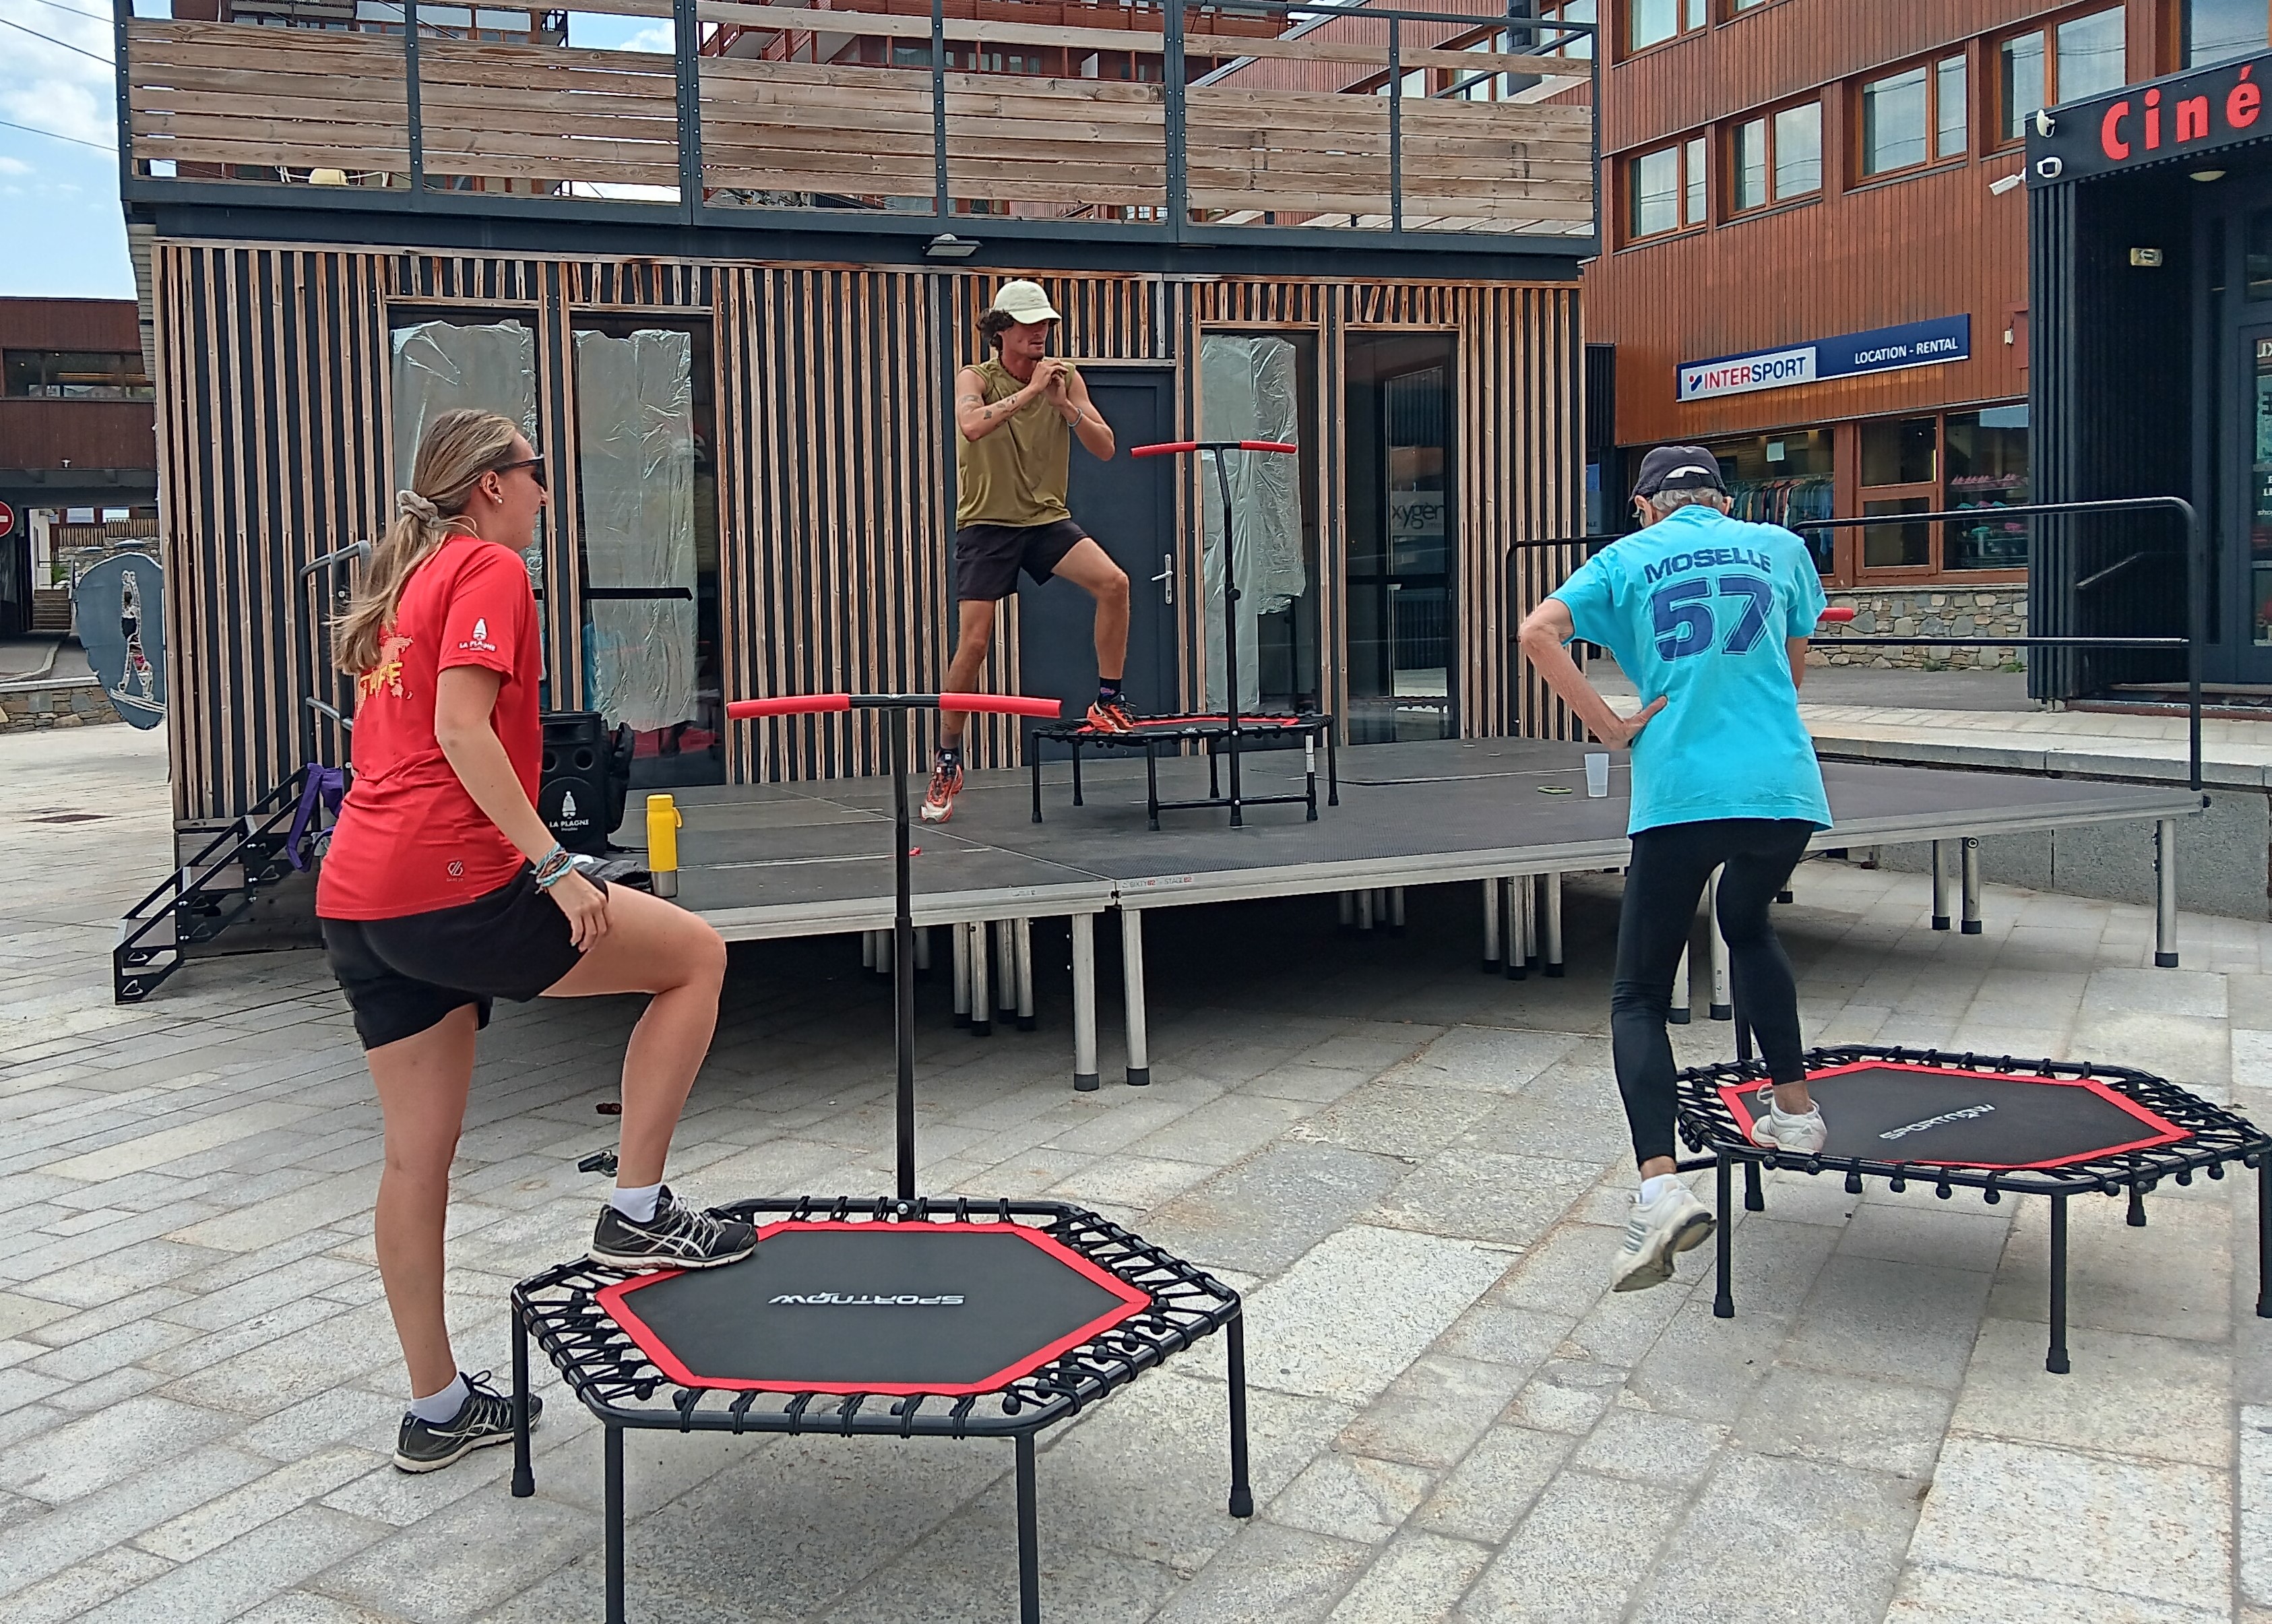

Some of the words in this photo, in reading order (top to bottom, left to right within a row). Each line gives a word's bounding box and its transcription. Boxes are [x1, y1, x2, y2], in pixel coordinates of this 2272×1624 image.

[2102, 65, 2261, 160] Ciné
[1855, 345, 1907, 364] LOCATION
[1916, 337, 1959, 355] RENTAL
[1703, 356, 1807, 390] INTERSPORT
[1644, 548, 1771, 584] MOSELLE
[1650, 573, 1775, 662] 57
[560, 819, 590, 827] PLAGNE
[1879, 1104, 1996, 1140] SPORTNOW
[768, 1292, 966, 1305] SPORTNOW
